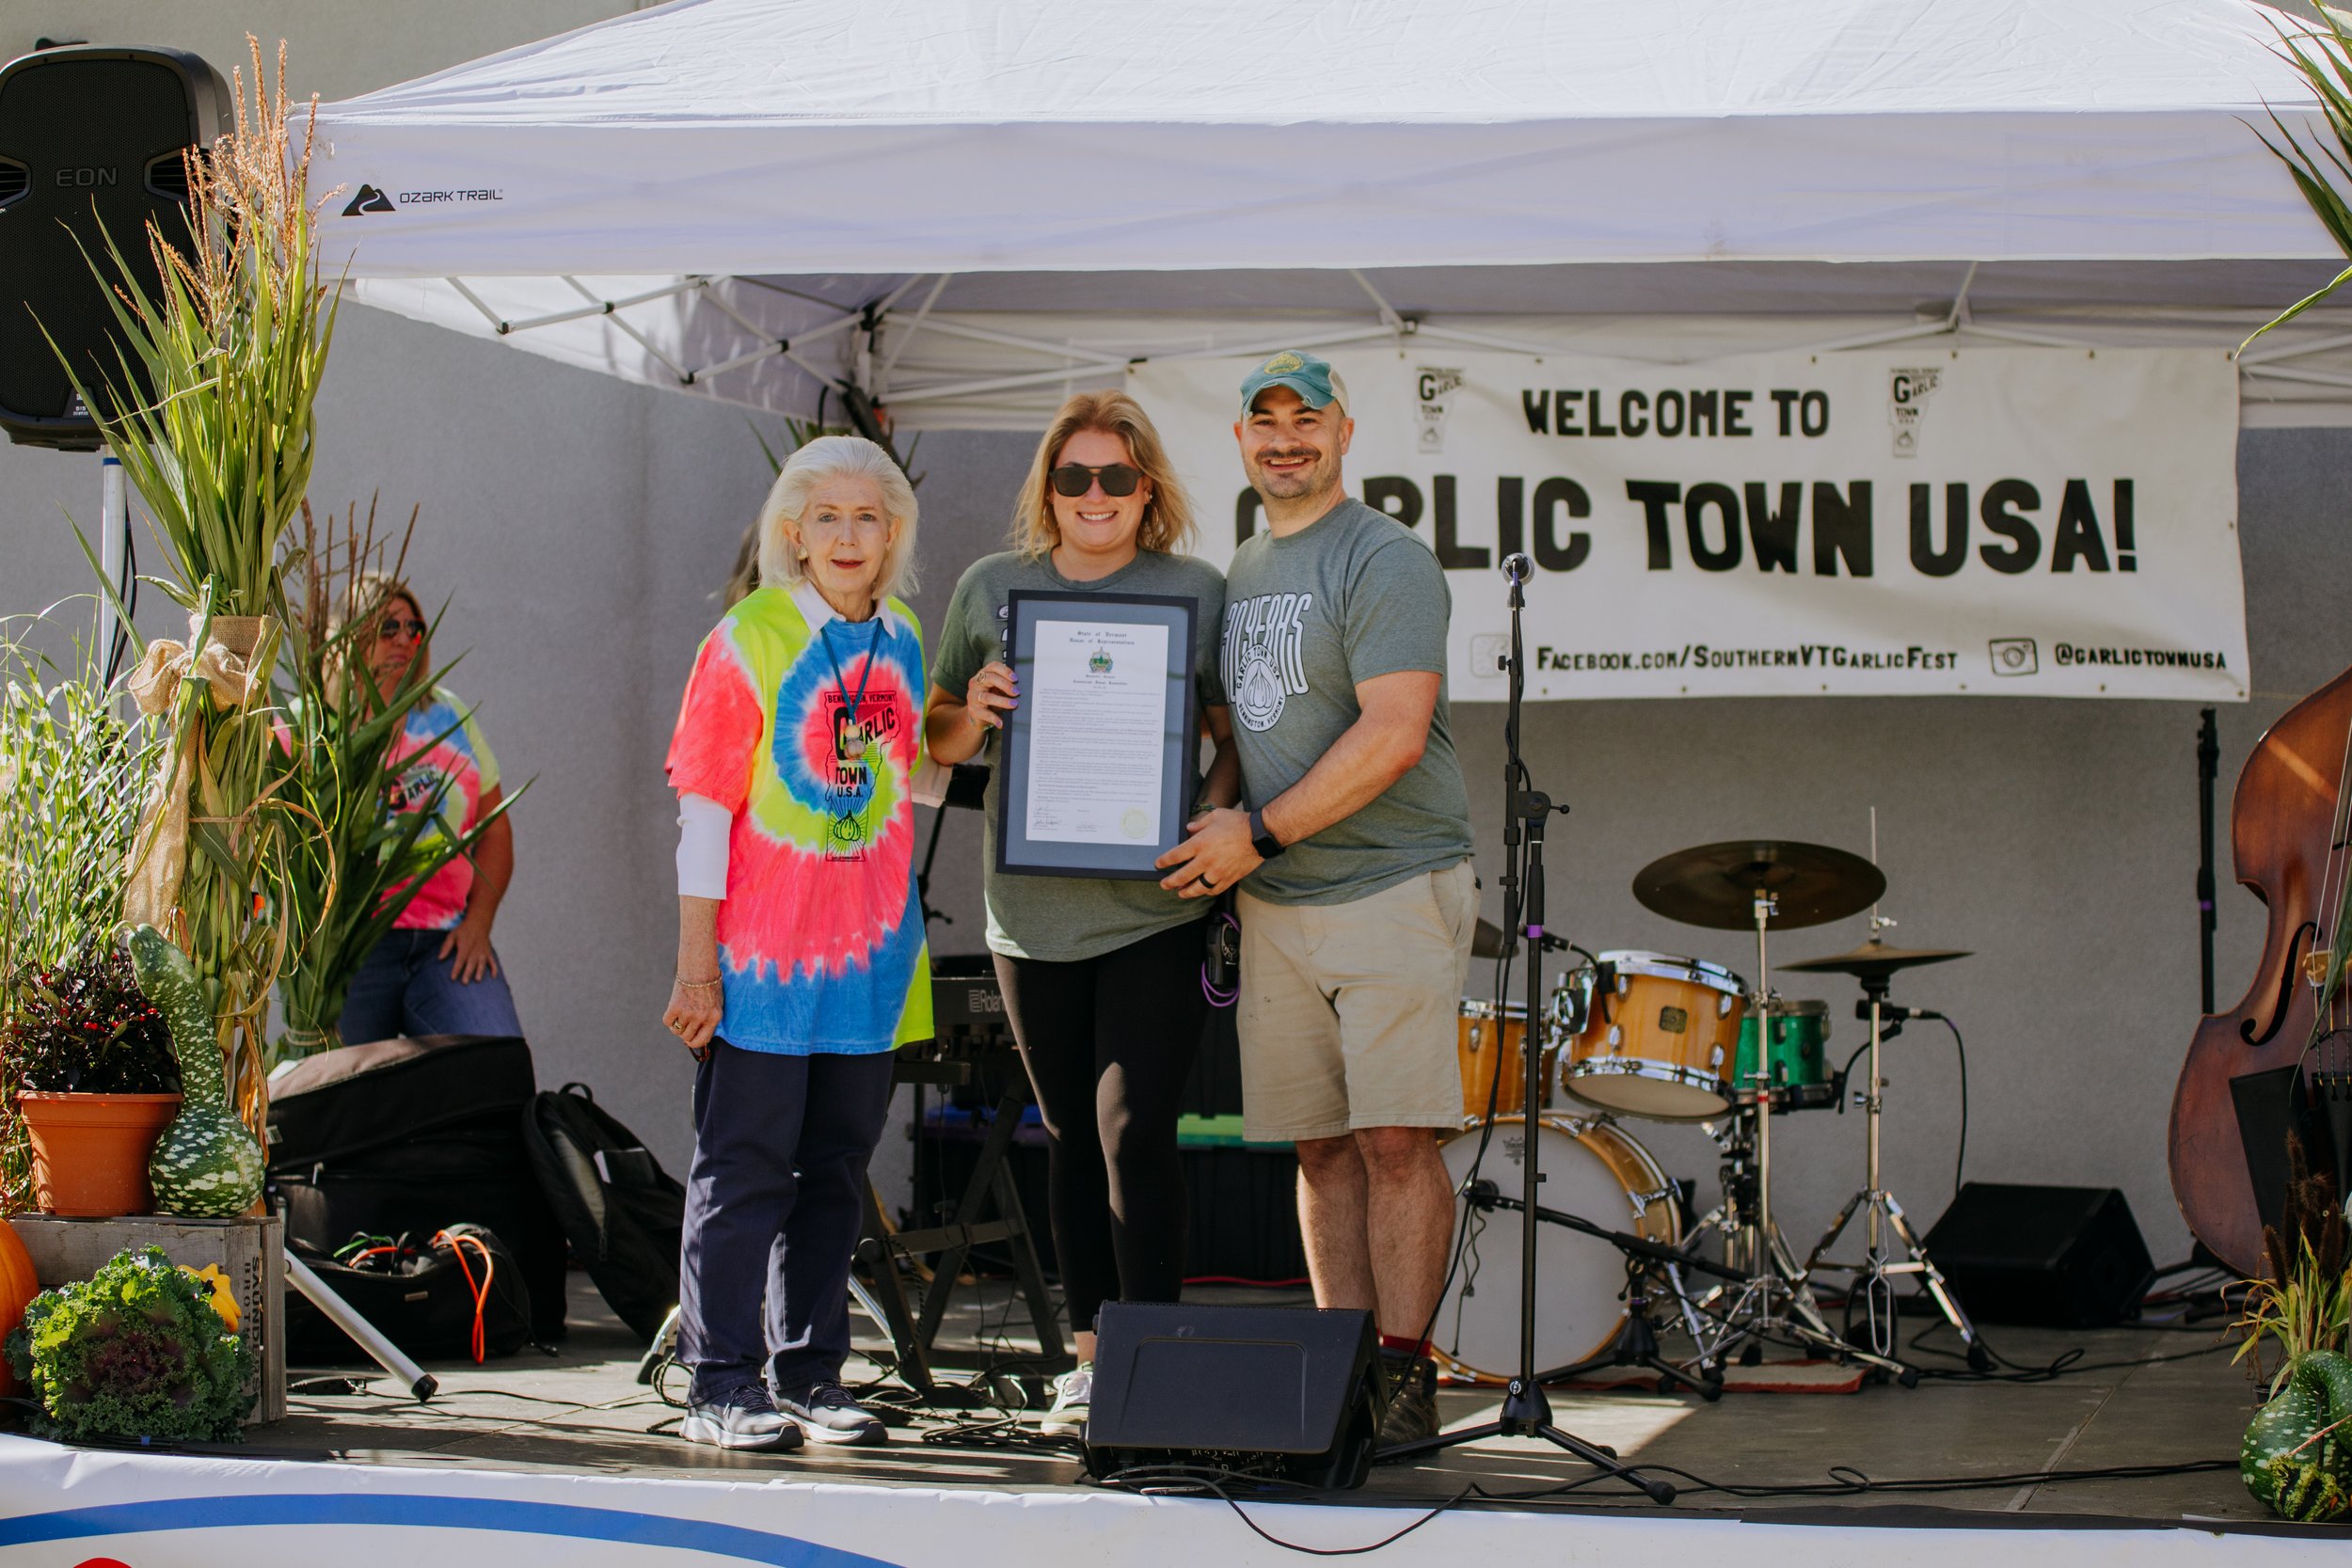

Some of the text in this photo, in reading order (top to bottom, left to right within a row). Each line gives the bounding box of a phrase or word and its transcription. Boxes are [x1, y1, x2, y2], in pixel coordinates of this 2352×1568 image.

[56, 167, 117, 186] EON
[399, 189, 503, 203] OZARK TRAIL
[1522, 388, 1830, 439] WELCOME TO
[1235, 475, 2138, 578] RLIC TOWN USA!
[1236, 652, 1252, 689] GARLIC
[1269, 658, 1280, 681] USA
[868, 693, 896, 703] VERMONT
[834, 766, 867, 785] TOWN
[836, 786, 864, 799] U.S.A.
[979, 989, 1006, 1013] Rolan
[252, 1256, 261, 1393] SAUNDERS
